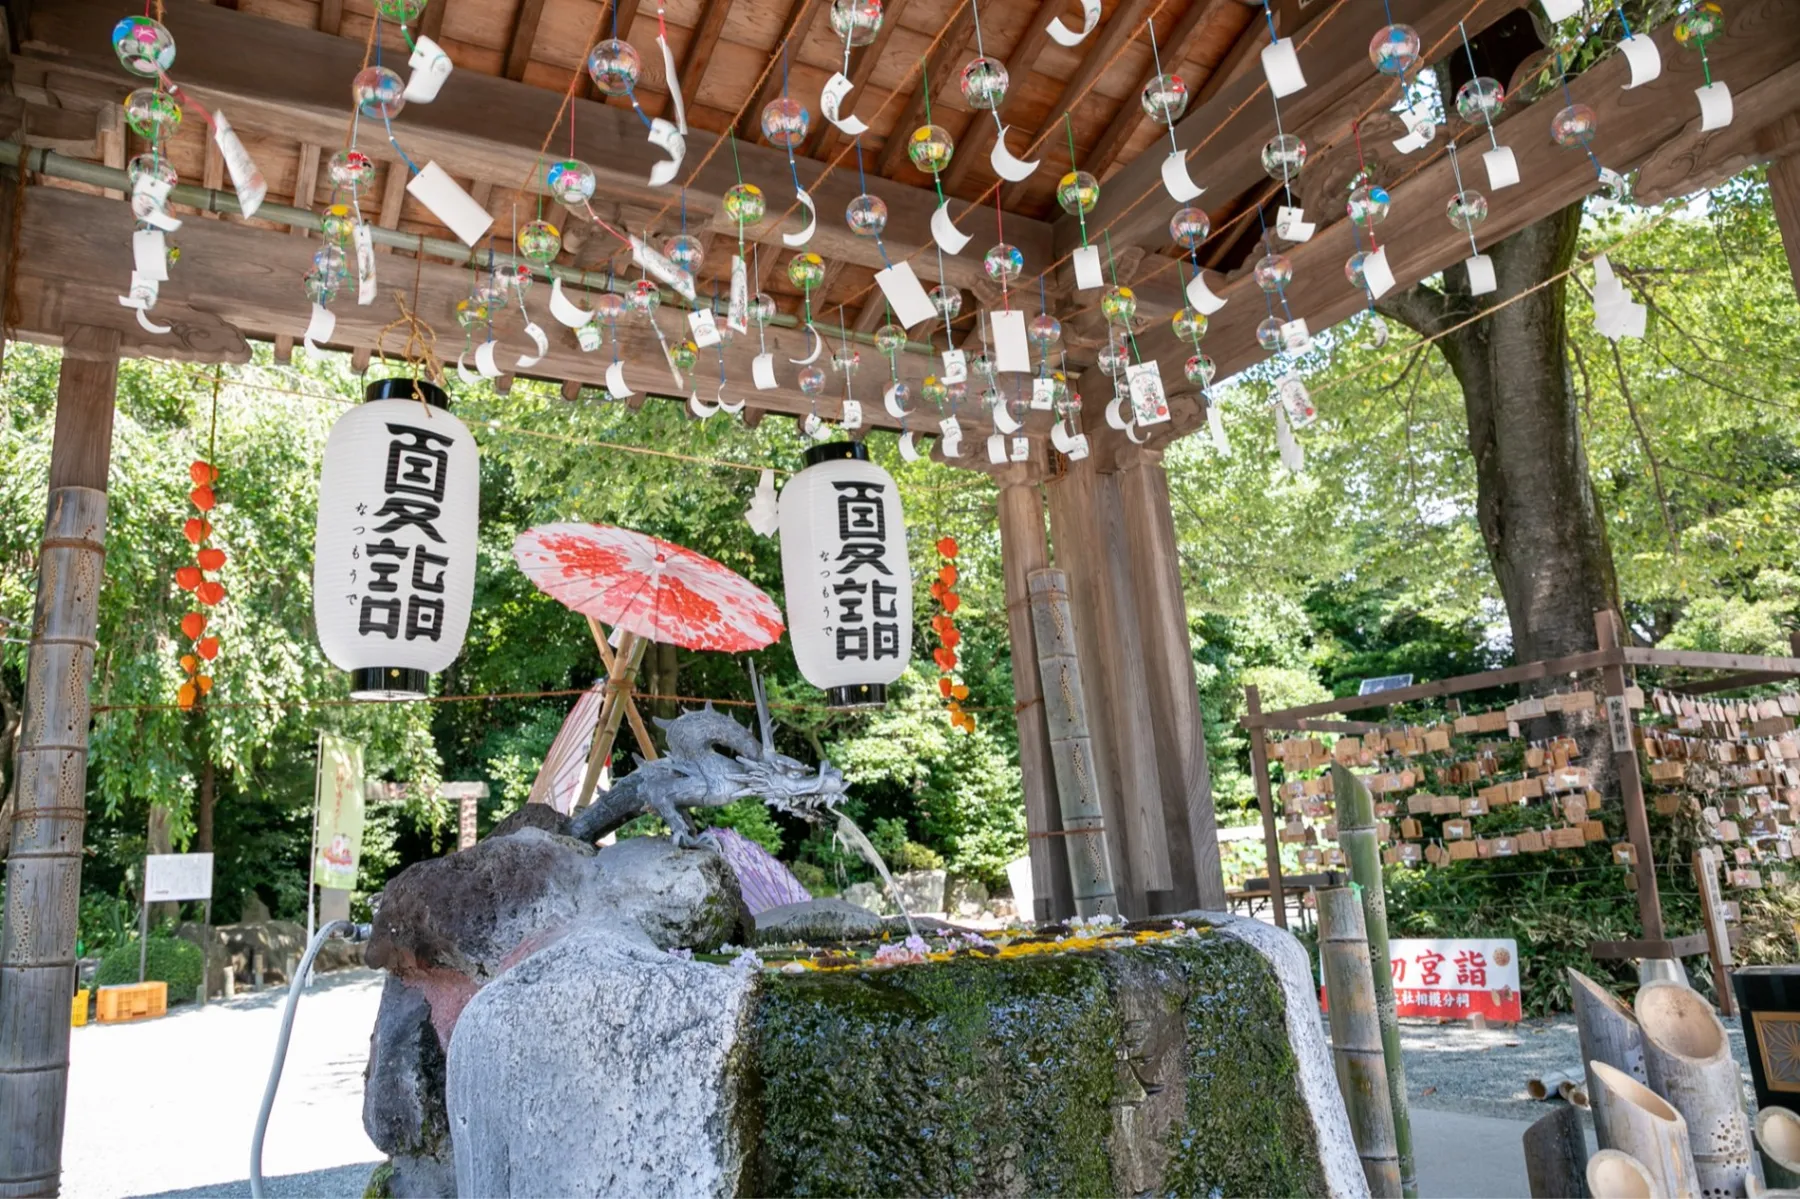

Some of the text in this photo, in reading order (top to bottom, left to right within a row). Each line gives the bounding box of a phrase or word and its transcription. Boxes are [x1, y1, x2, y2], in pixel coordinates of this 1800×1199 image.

[346, 503, 368, 606] なつもうで
[359, 422, 455, 643] 夏詣
[819, 551, 832, 637] なつもうで
[831, 481, 899, 661] 夏詣
